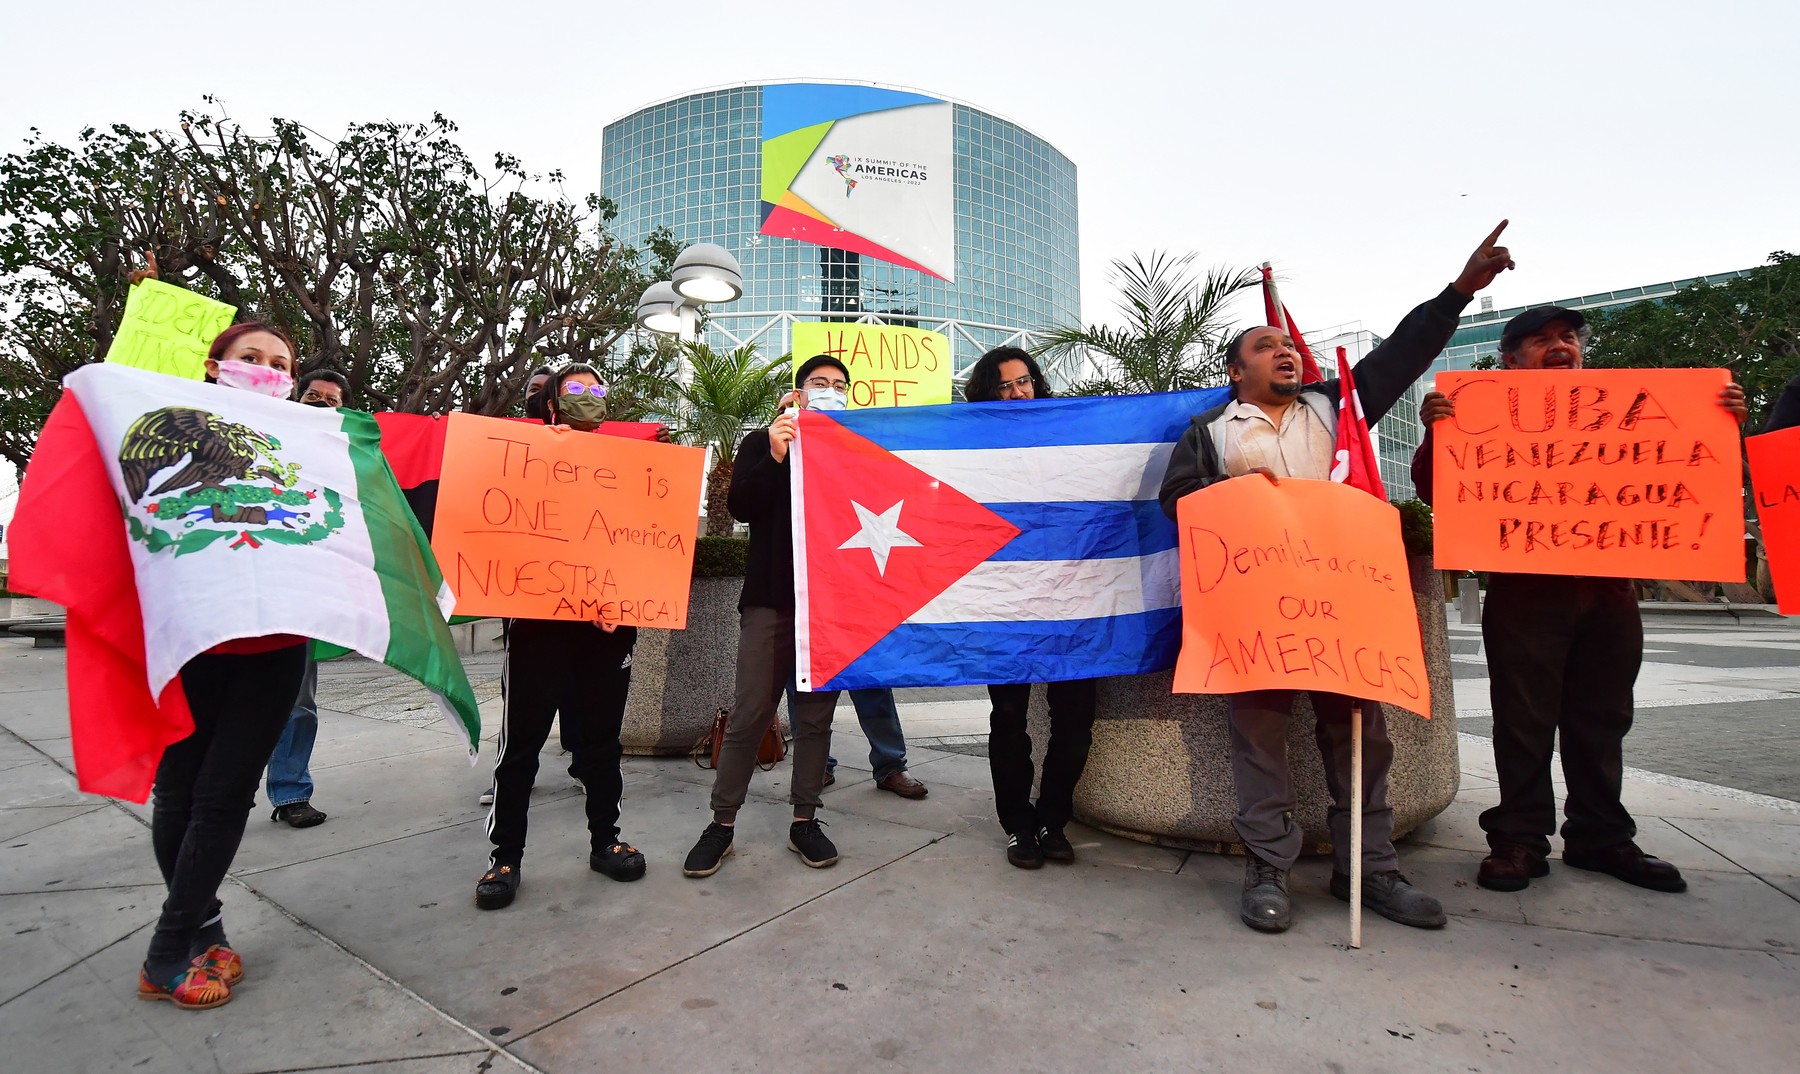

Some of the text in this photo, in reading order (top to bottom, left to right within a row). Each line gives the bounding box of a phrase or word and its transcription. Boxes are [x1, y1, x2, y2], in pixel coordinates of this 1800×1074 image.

[855, 164, 928, 181] AMERICAS
[865, 158, 896, 166] SUMMIT
[912, 163, 927, 171] THE
[823, 330, 938, 372] HANDS
[852, 379, 918, 408] OFF
[1448, 378, 1678, 435] CUBA
[487, 437, 669, 498] There is
[1446, 440, 1721, 470] VENEZUELA
[1457, 480, 1700, 508] NICARAGUA
[482, 487, 686, 556] ONE America
[1499, 512, 1714, 554] PRESENTE!
[457, 551, 618, 598] NUESTRA
[1189, 526, 1396, 593] Demilitarize
[552, 597, 679, 623] AMERICA!
[1278, 595, 1340, 621] OUR
[1204, 630, 1420, 700] AMERICAS
